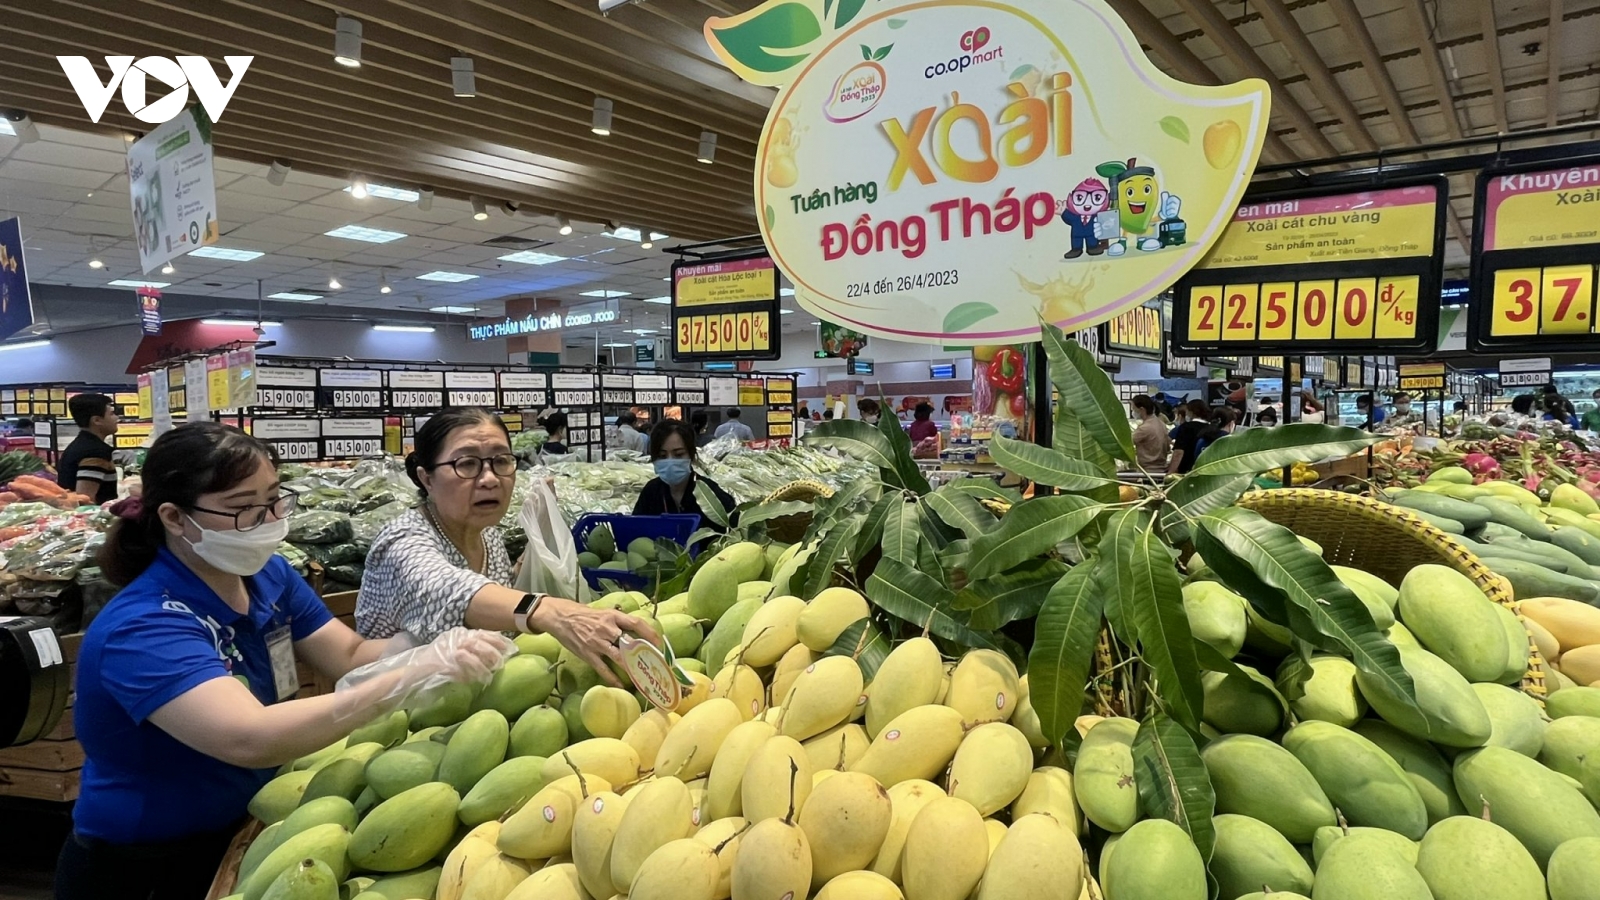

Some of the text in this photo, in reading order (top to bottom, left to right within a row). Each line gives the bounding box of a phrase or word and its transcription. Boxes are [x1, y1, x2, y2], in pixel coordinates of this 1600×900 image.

[790, 181, 877, 214] Tuần hàng
[820, 187, 1055, 261] Đồng Tháp
[1247, 210, 1381, 232] Xoài cát chu vàng
[1265, 236, 1355, 251] Sản phẩm an toàn
[847, 269, 959, 298] 22/4 đến 26/4/2023
[1196, 287, 1367, 330] 22.500
[1505, 277, 1587, 322] 37.
[470, 324, 493, 340] THỰC
[494, 317, 519, 336] PHẨM
[519, 314, 538, 333] NẤU
[540, 312, 562, 330] CHÍN
[565, 314, 592, 327] COOKED
[680, 318, 750, 346] 37.500
[257, 392, 303, 404] 15.900
[335, 392, 369, 404] 9.500
[395, 393, 433, 404] 17.500
[451, 393, 487, 404] 19.900
[329, 442, 370, 453] 14.500
